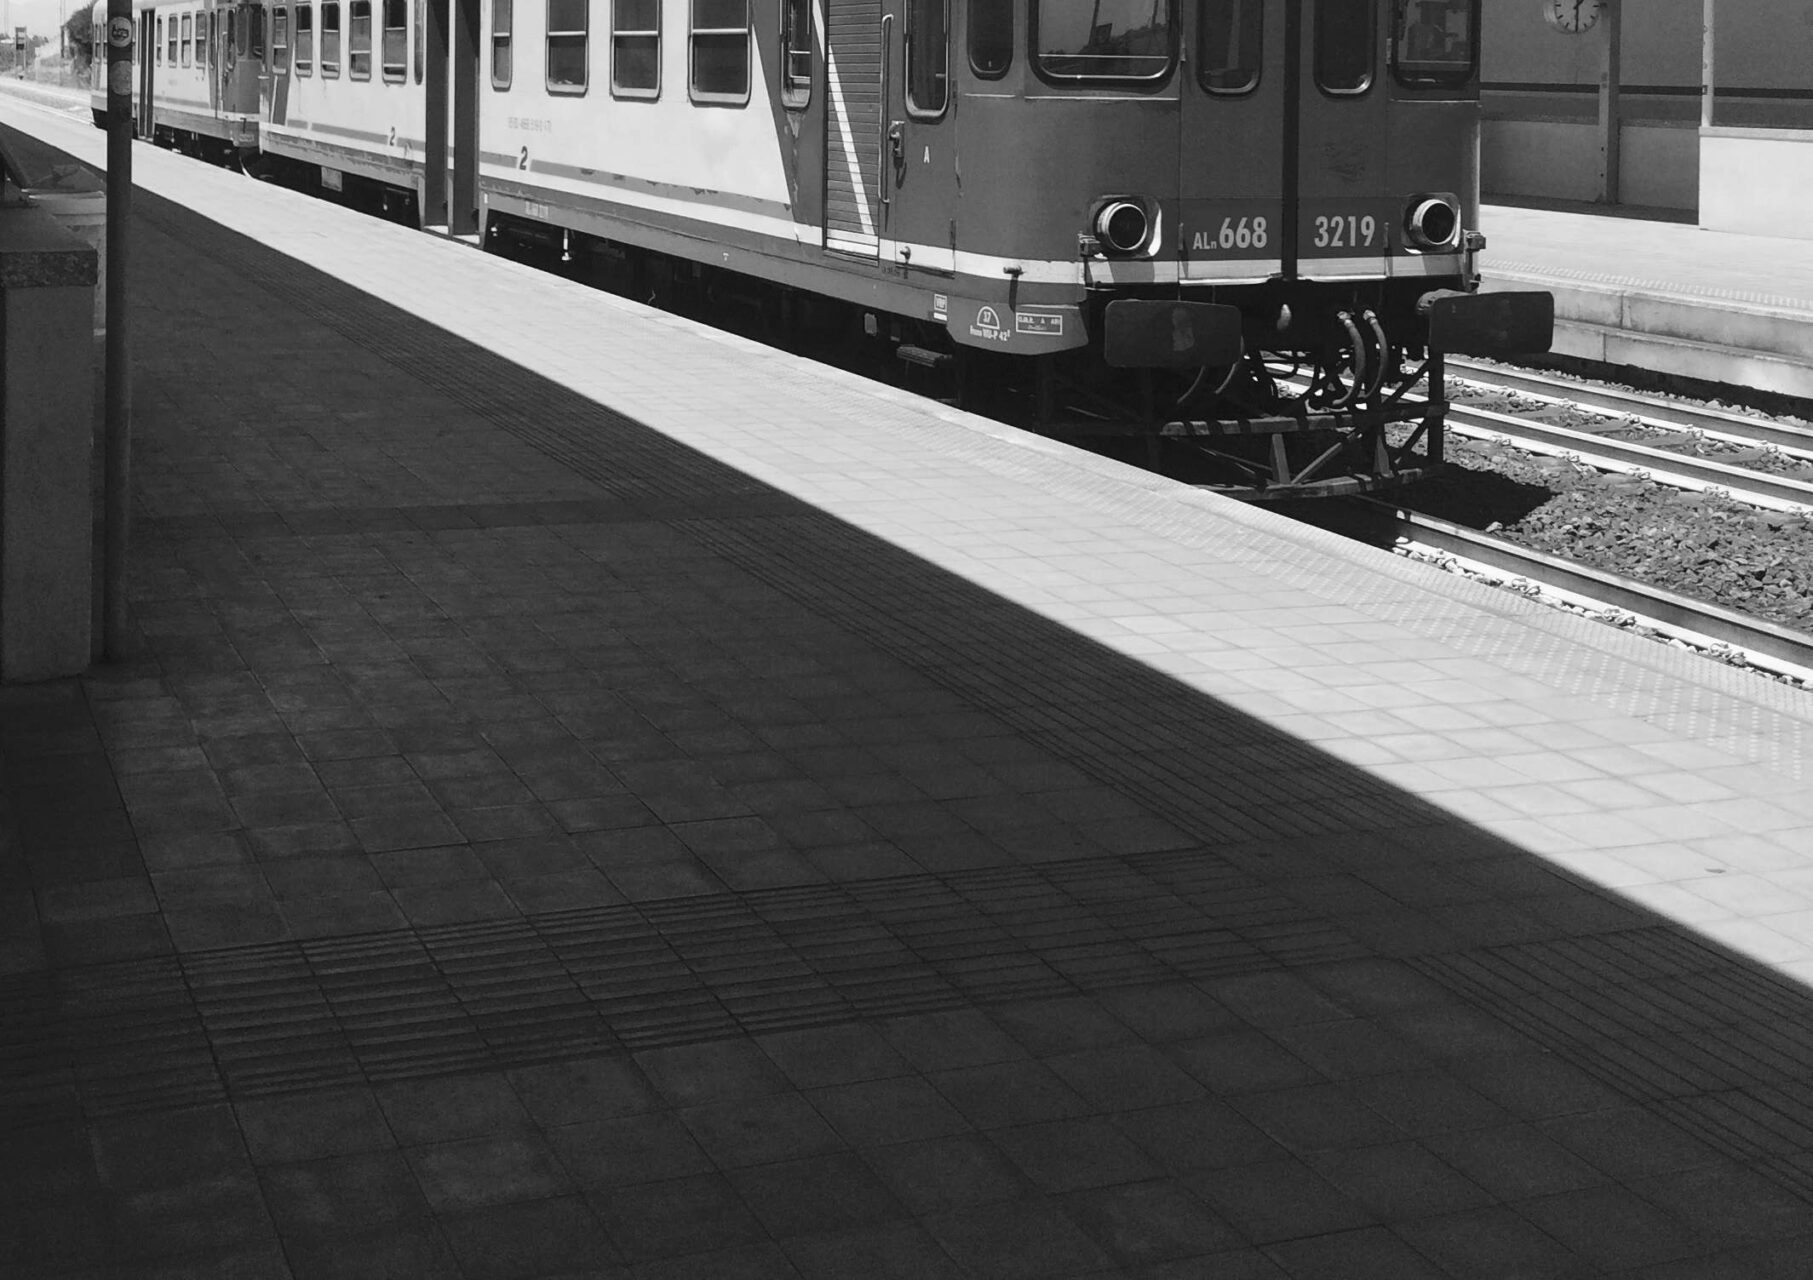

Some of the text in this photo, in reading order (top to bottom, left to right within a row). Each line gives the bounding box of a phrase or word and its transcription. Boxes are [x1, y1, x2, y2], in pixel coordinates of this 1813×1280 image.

[519, 145, 529, 171] 2
[923, 145, 930, 164] A
[1219, 216, 1268, 249] 668
[1314, 215, 1376, 248] 3219
